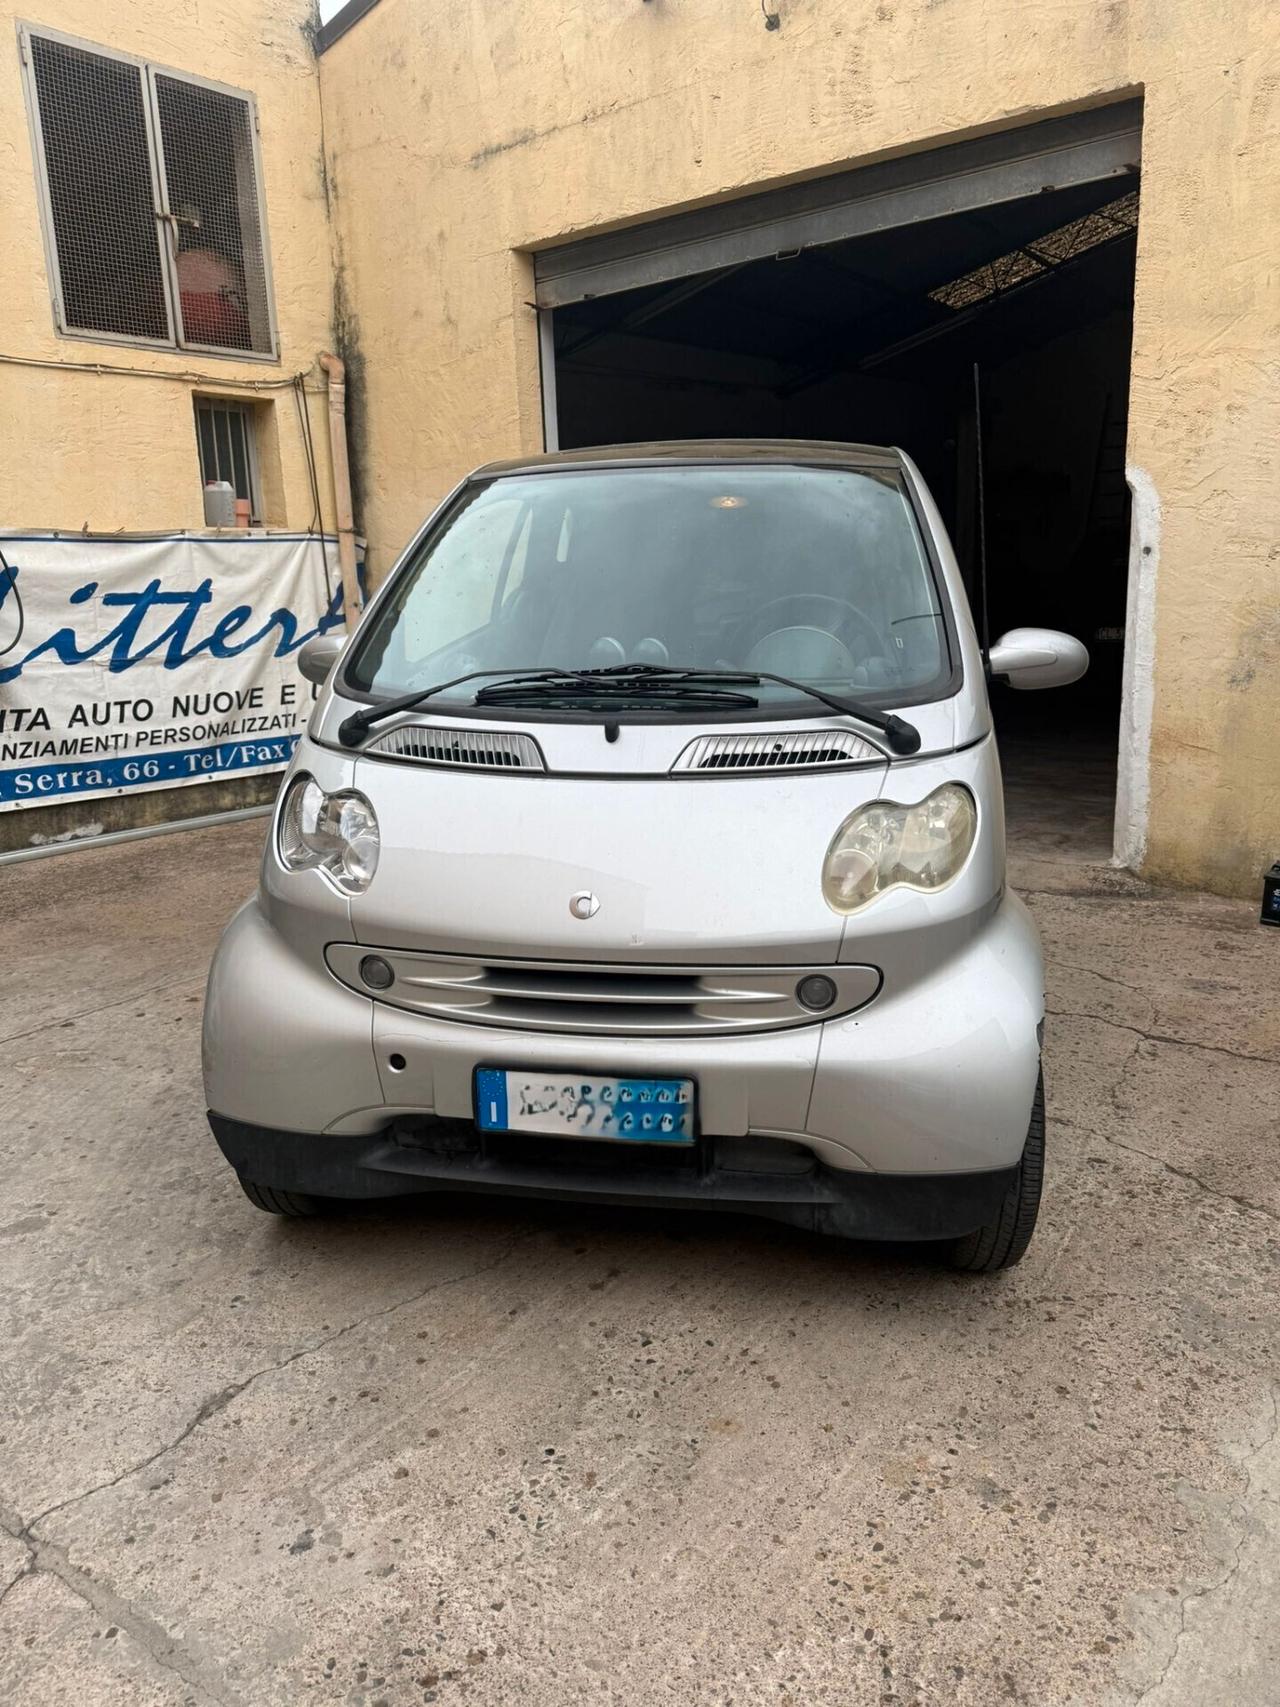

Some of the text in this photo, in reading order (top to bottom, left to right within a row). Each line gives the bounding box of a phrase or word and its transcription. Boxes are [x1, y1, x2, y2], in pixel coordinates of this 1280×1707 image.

[68, 699, 154, 729] AUTO
[172, 687, 264, 718] NUOVE
[280, 684, 296, 705] E
[135, 713, 297, 748] PERSONALIZZATI
[14, 769, 113, 795] Serra,
[123, 759, 160, 781] 66
[184, 743, 285, 772] Tel/Fax
